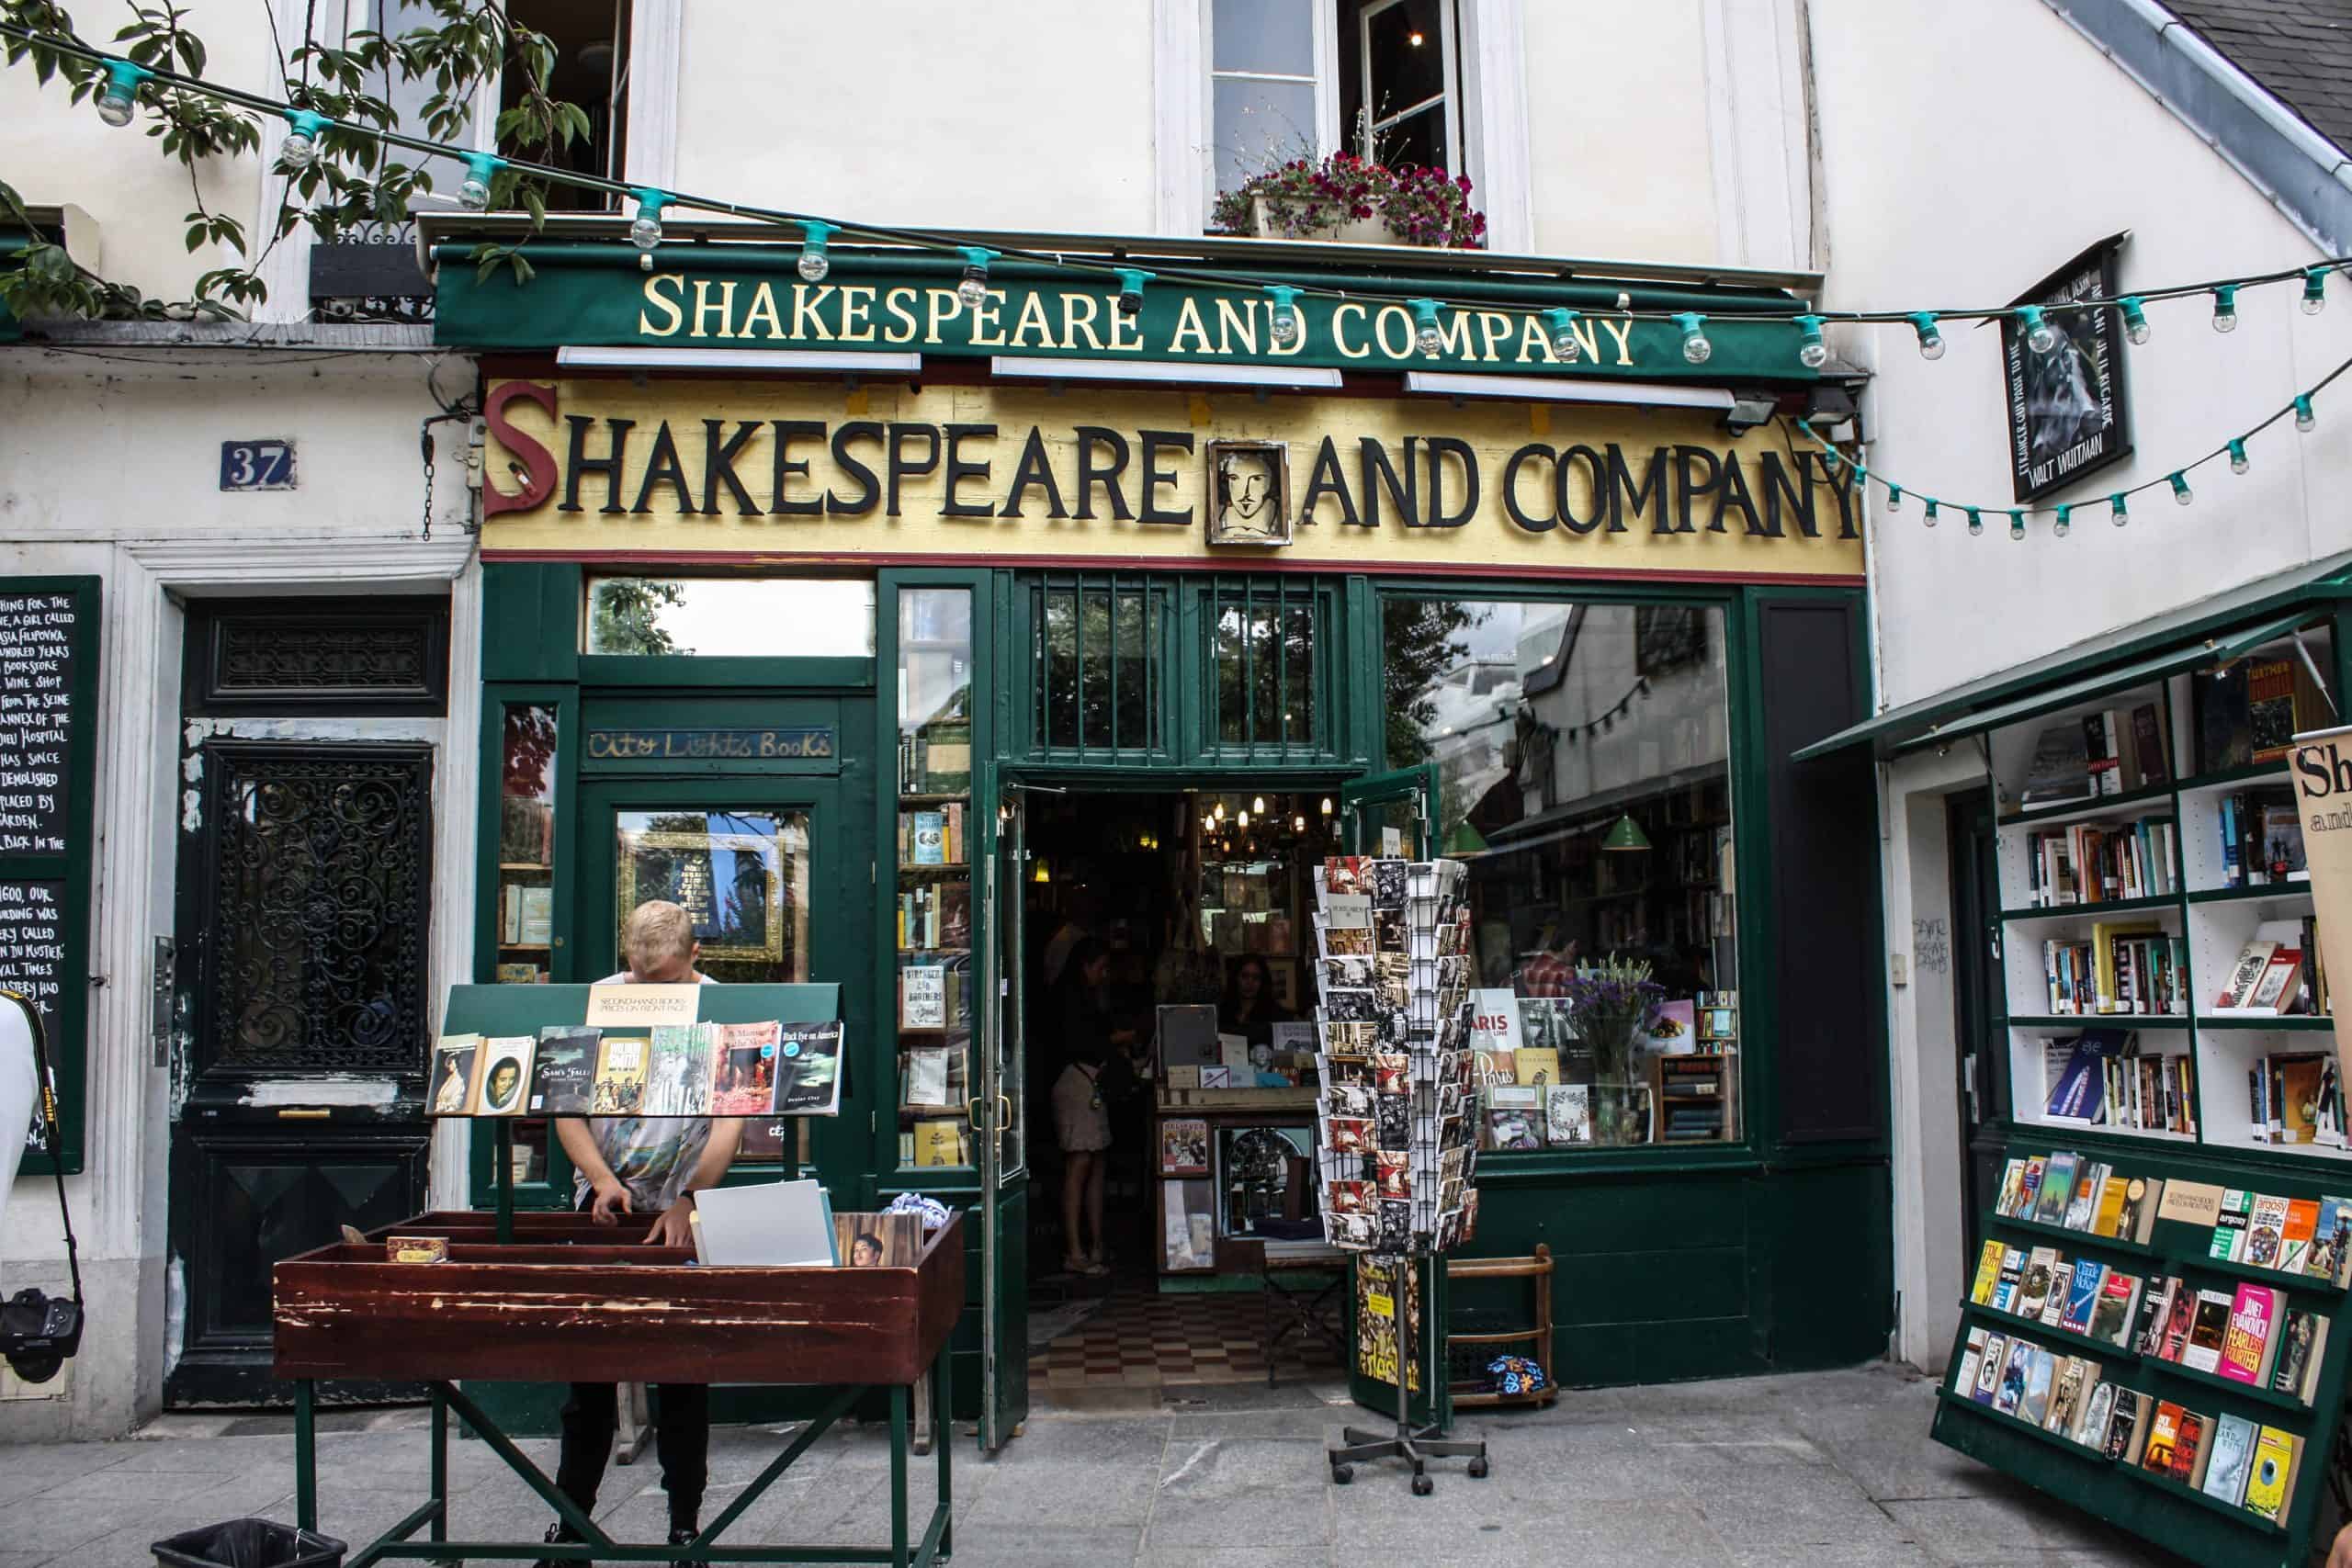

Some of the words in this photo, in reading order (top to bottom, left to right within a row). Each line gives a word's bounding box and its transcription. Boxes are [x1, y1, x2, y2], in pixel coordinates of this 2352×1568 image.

[639, 274, 1144, 352] SHAKESPEARE
[1168, 298, 1307, 355] AND
[1332, 303, 1634, 366] COMPANY
[232, 447, 284, 485] 37
[482, 381, 1195, 525] SHAKESPEARE
[1296, 435, 1480, 527] AND
[1503, 442, 1860, 539] COMPANY
[2029, 458, 2055, 489] WALT
[2057, 432, 2103, 478] WHITMAN
[27, 597, 47, 612] FOR
[50, 596, 71, 609] THE
[13, 615, 21, 625] A
[23, 615, 42, 626] GIRL
[45, 613, 74, 625] CALLED
[39, 645, 70, 659] YEARS
[5, 676, 31, 690] WINE
[36, 675, 62, 689] SHOP
[1, 694, 23, 710] FROM
[22, 694, 40, 709] THE
[43, 693, 71, 708] SEINE
[36, 714, 48, 726] OF
[51, 713, 71, 728] THE
[21, 727, 68, 750] HOSPITAL
[589, 732, 658, 758] City
[664, 732, 752, 758] Lights
[1, 753, 20, 767] HAS
[28, 751, 60, 766] SINCE
[1, 772, 58, 787] DEMOLISHED
[39, 794, 54, 813] BY
[4, 835, 30, 850] BACK
[35, 835, 45, 850] IN
[47, 837, 65, 850] THE
[29, 886, 54, 903] OUR
[37, 908, 58, 920] WAS
[22, 927, 54, 940] CALLED
[10, 945, 23, 958] DU
[20, 962, 52, 976] TIMES
[40, 981, 59, 996] HAD
[44, 1087, 54, 1122] Nikon
[2242, 1295, 2263, 1317] JANET
[2232, 1313, 2267, 1340] EVANOVICH
[2227, 1326, 2264, 1356] FEARLESS
[2224, 1345, 2260, 1374] FOURTEEN
